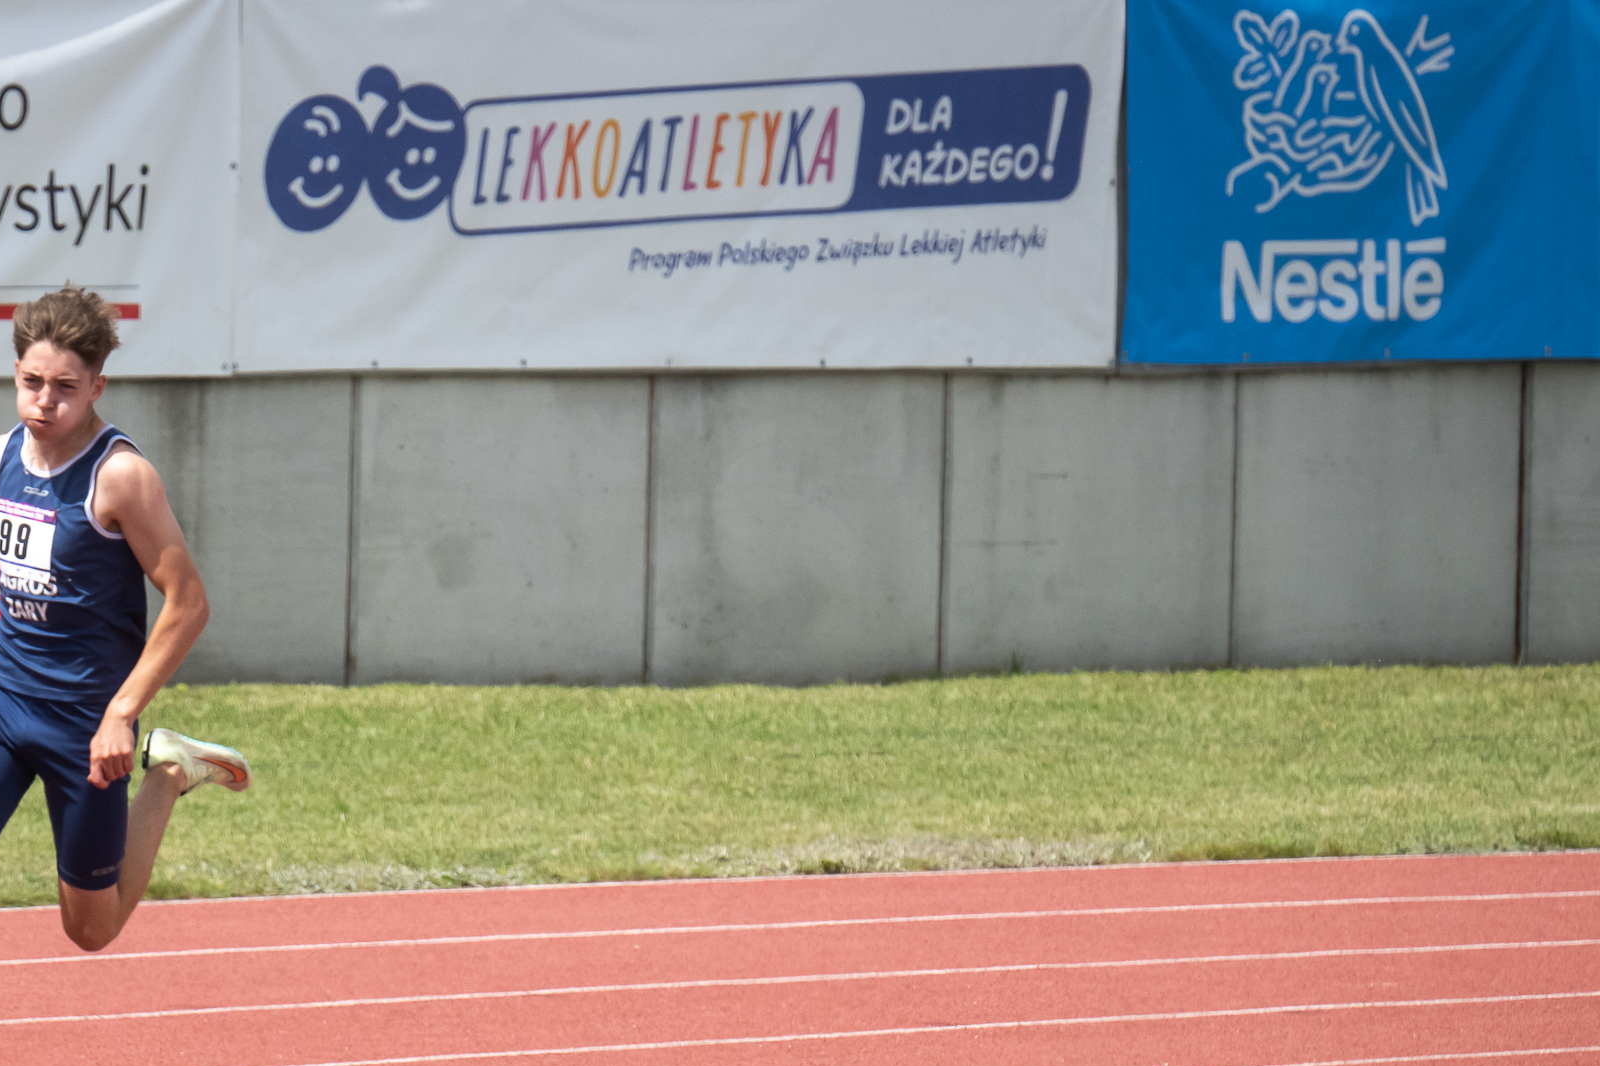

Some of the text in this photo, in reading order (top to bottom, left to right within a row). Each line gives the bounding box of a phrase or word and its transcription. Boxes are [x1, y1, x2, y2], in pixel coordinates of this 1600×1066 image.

[885, 96, 953, 135] DLA
[472, 106, 840, 204] LEKKOATLETYKA
[628, 224, 1048, 279] Program Polskiego Związku Lekkiej Atletyki
[1220, 236, 1447, 323] Nestlé
[0, 518, 31, 560] 99
